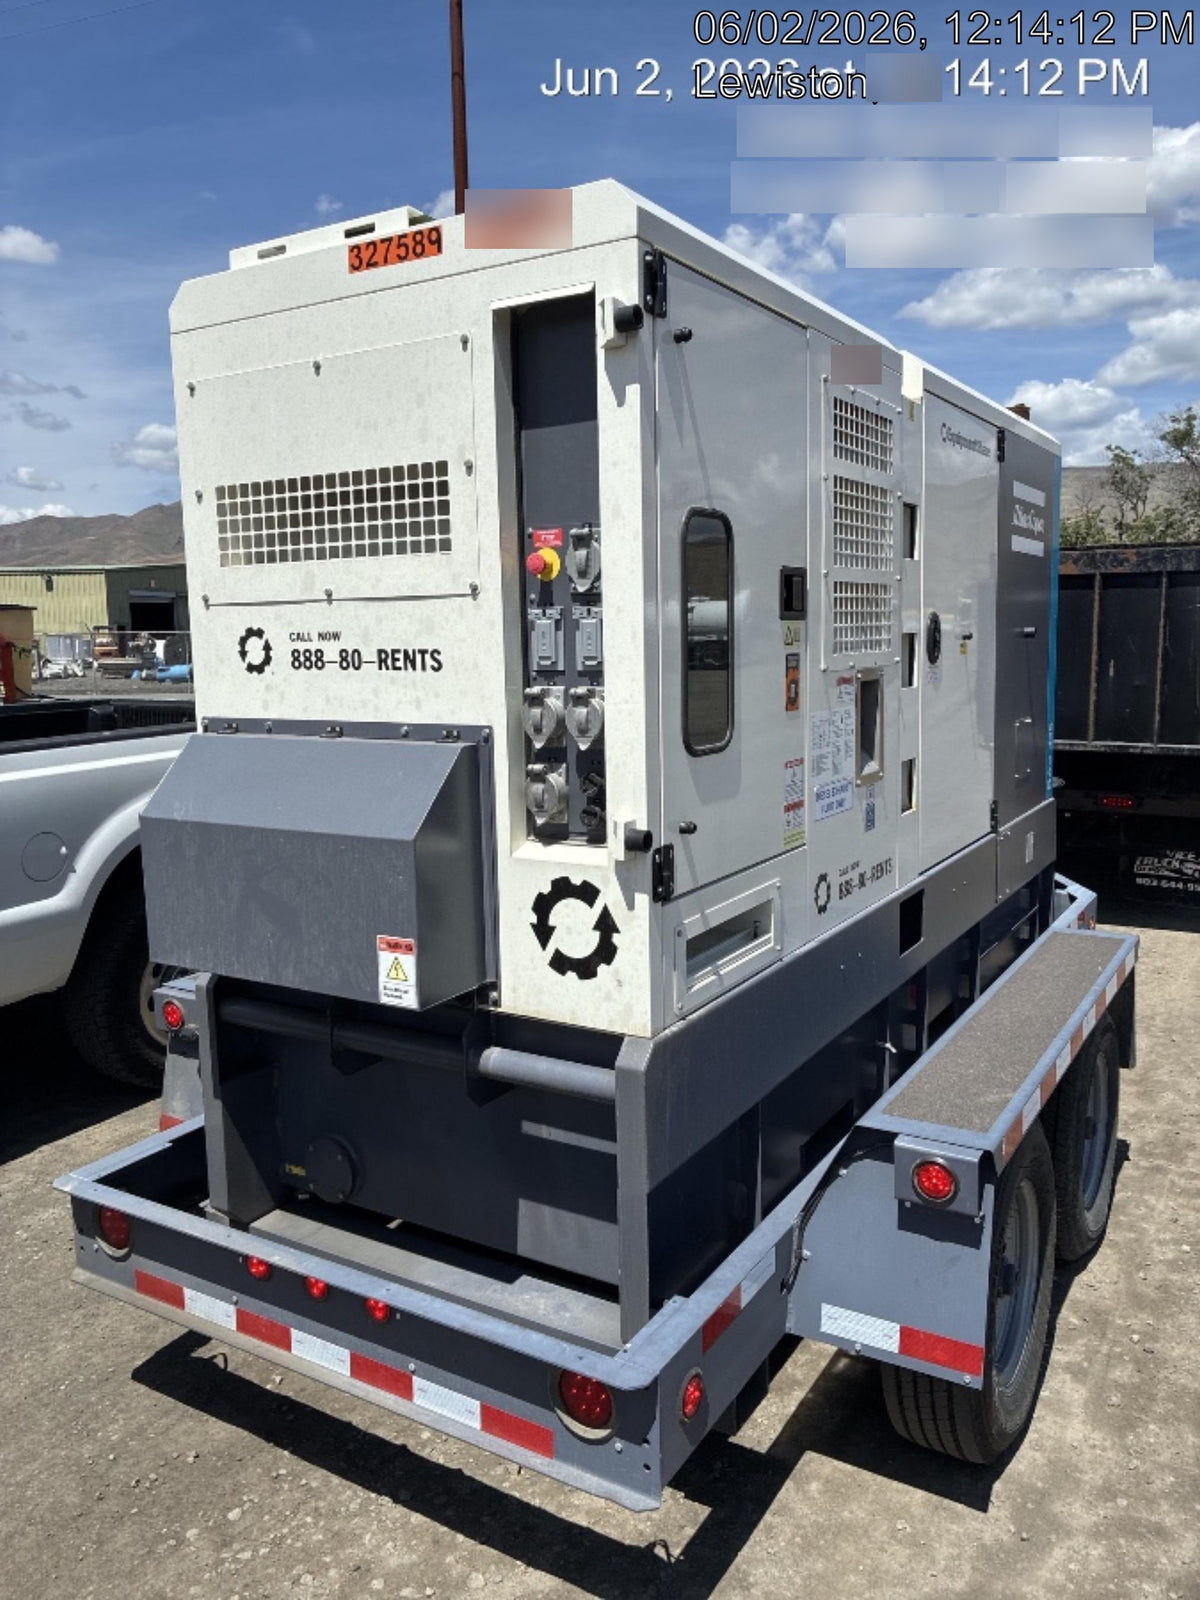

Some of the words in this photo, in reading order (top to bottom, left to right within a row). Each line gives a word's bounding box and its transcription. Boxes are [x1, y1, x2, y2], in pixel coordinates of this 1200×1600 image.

[349, 225, 443, 272] 327589
[289, 632, 313, 642] CALL
[317, 631, 342, 642] NOW
